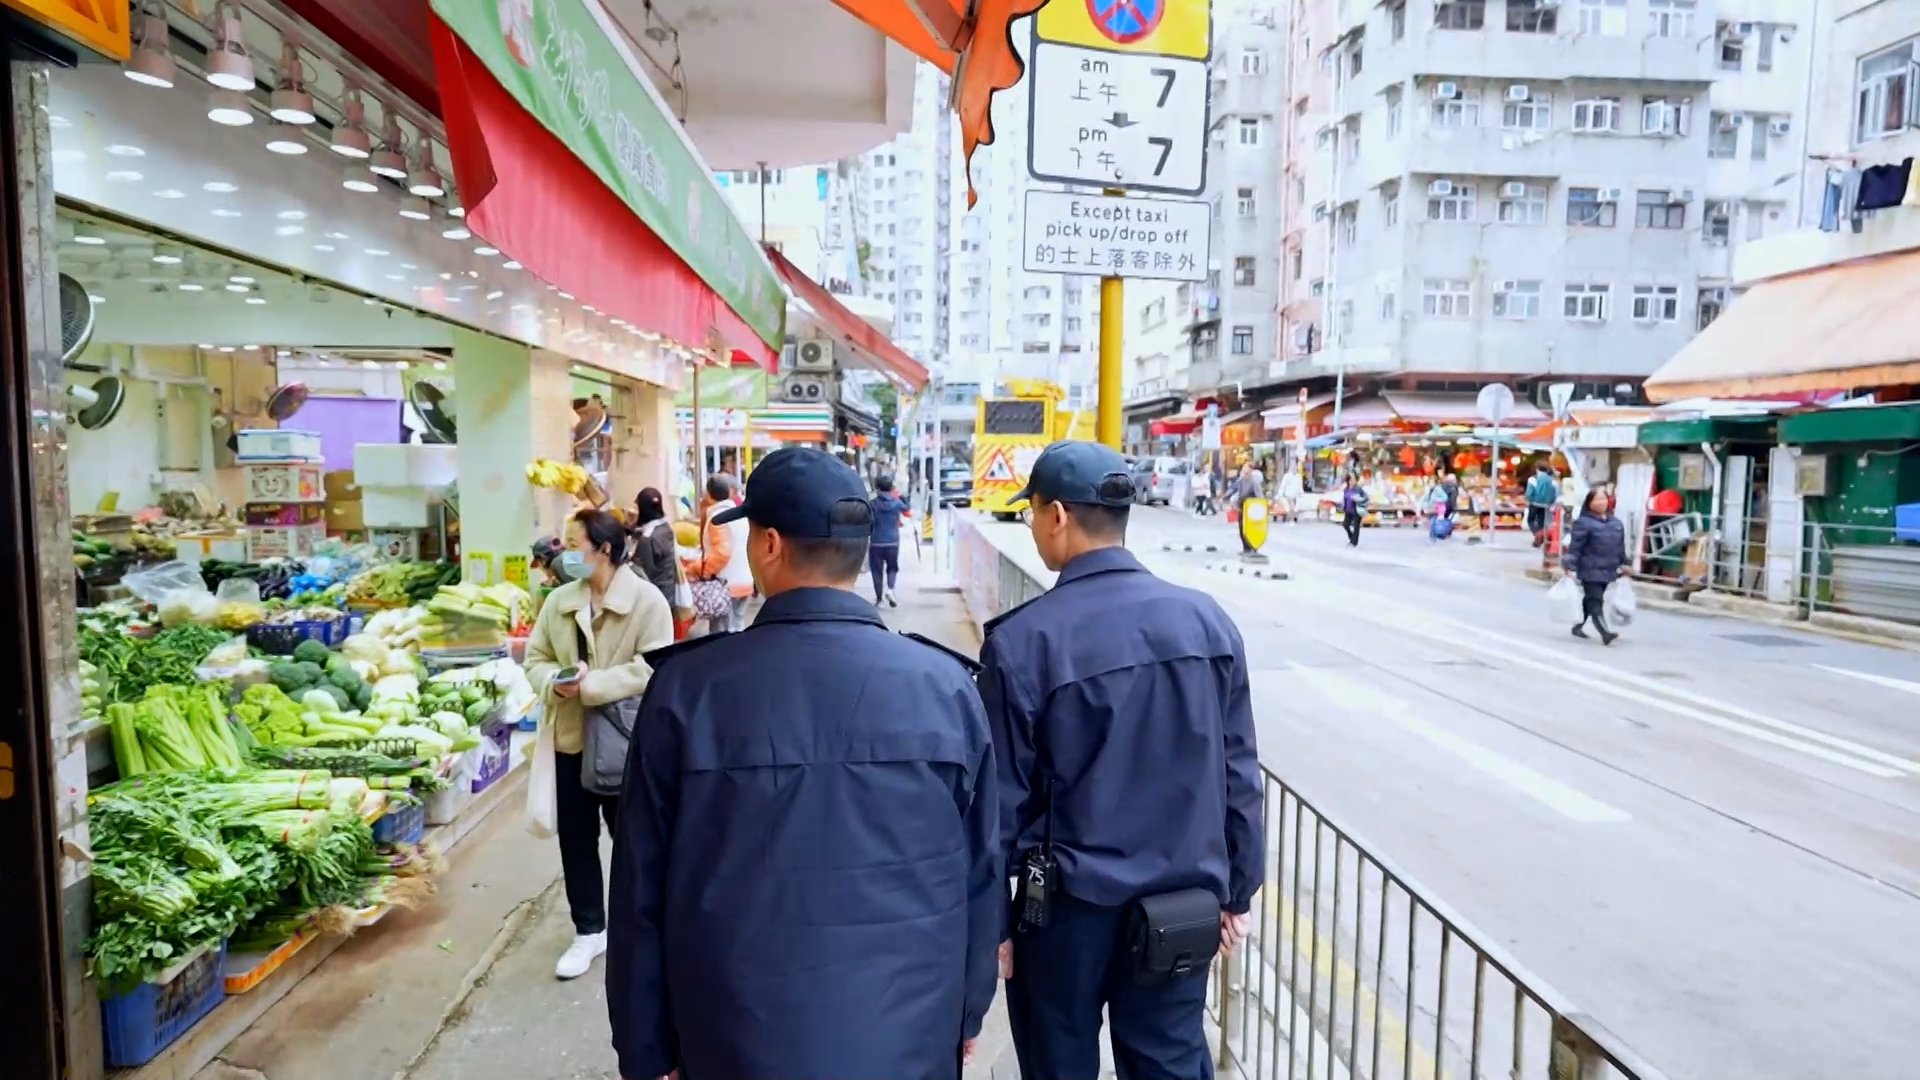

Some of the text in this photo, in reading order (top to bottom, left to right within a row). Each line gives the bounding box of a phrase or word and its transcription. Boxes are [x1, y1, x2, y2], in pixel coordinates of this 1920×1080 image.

[1081, 58, 1109, 73] am
[1071, 79, 1118, 105] 上午
[1150, 67, 1176, 108] 7
[1079, 127, 1107, 143] pm
[1069, 147, 1116, 171] 下午
[1147, 136, 1173, 176] 7
[1071, 201, 1168, 222] Except taxi
[1046, 221, 1188, 243] pick up/drop off
[1035, 243, 1196, 271] 的士上落客除外
